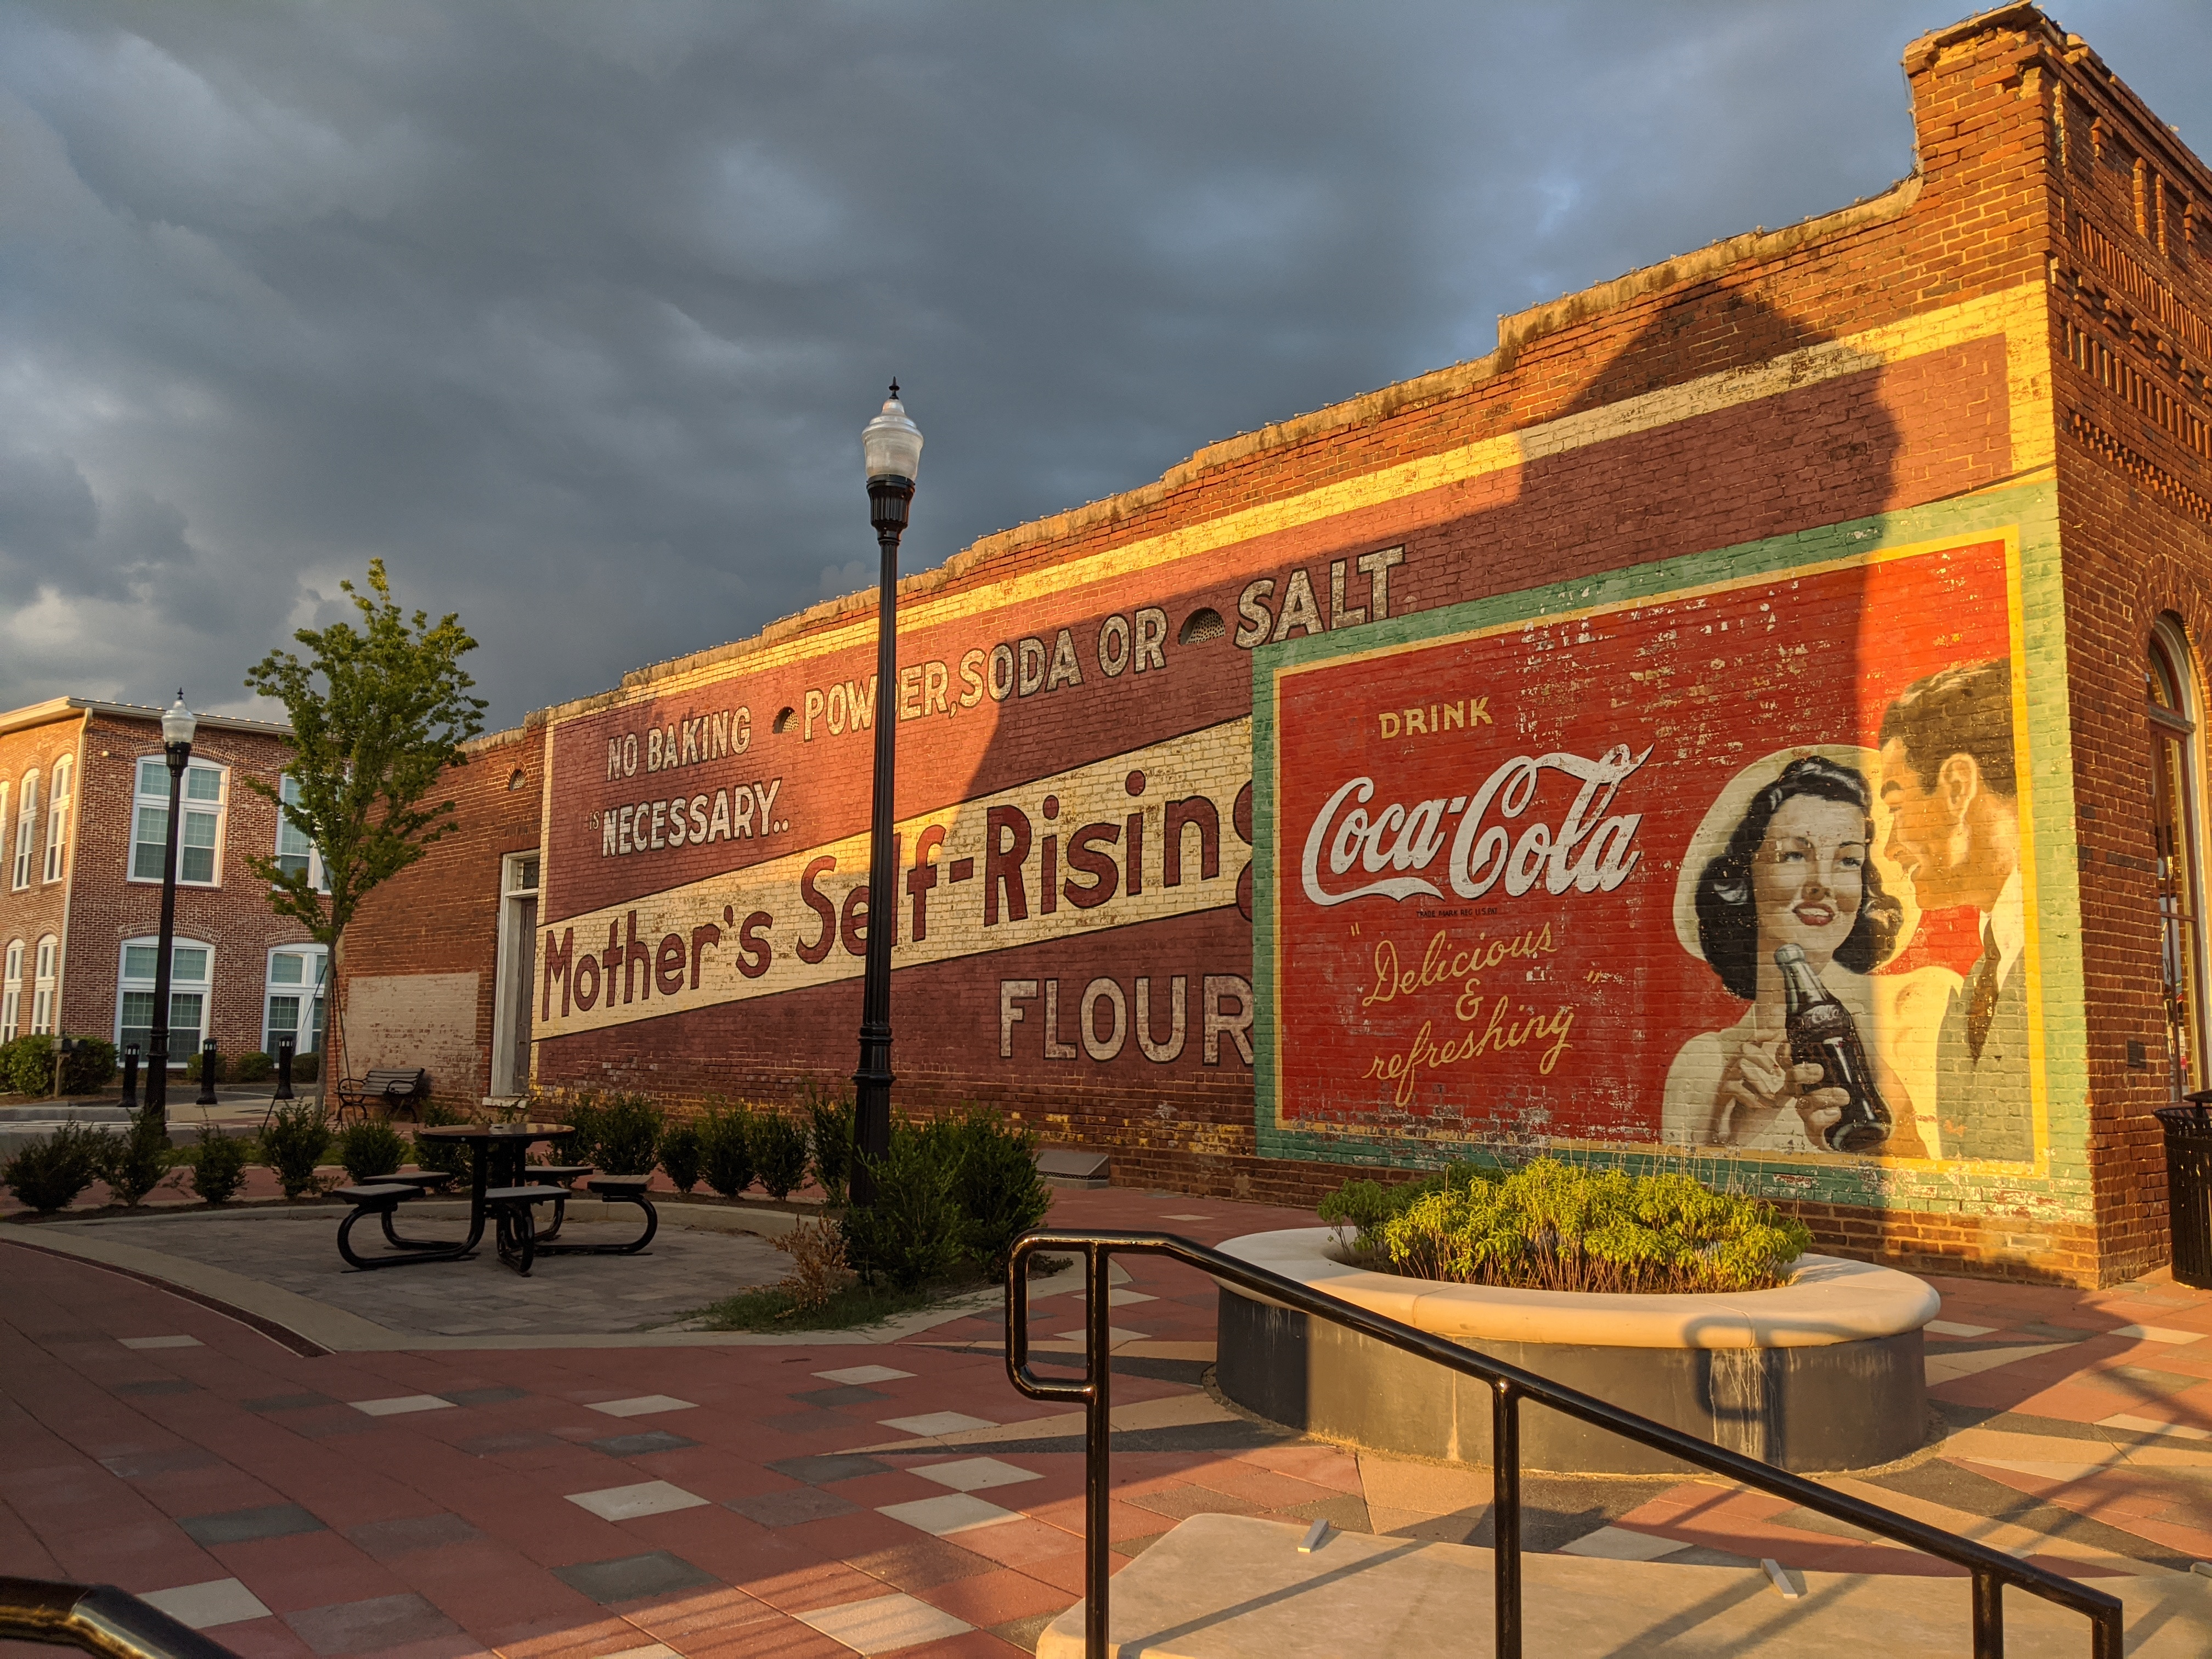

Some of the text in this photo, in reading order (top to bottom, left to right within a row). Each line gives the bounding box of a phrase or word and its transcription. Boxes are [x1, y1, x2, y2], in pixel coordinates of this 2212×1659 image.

[606, 544, 1406, 781] NO BAKING POWER, SODA OR SALT
[1378, 697, 1493, 739] DRINK
[1301, 743, 1655, 906] Coca-Cola
[541, 905, 772, 1022] Mother's
[1455, 978, 1483, 1021] &
[998, 973, 1254, 1066] FLOUR
